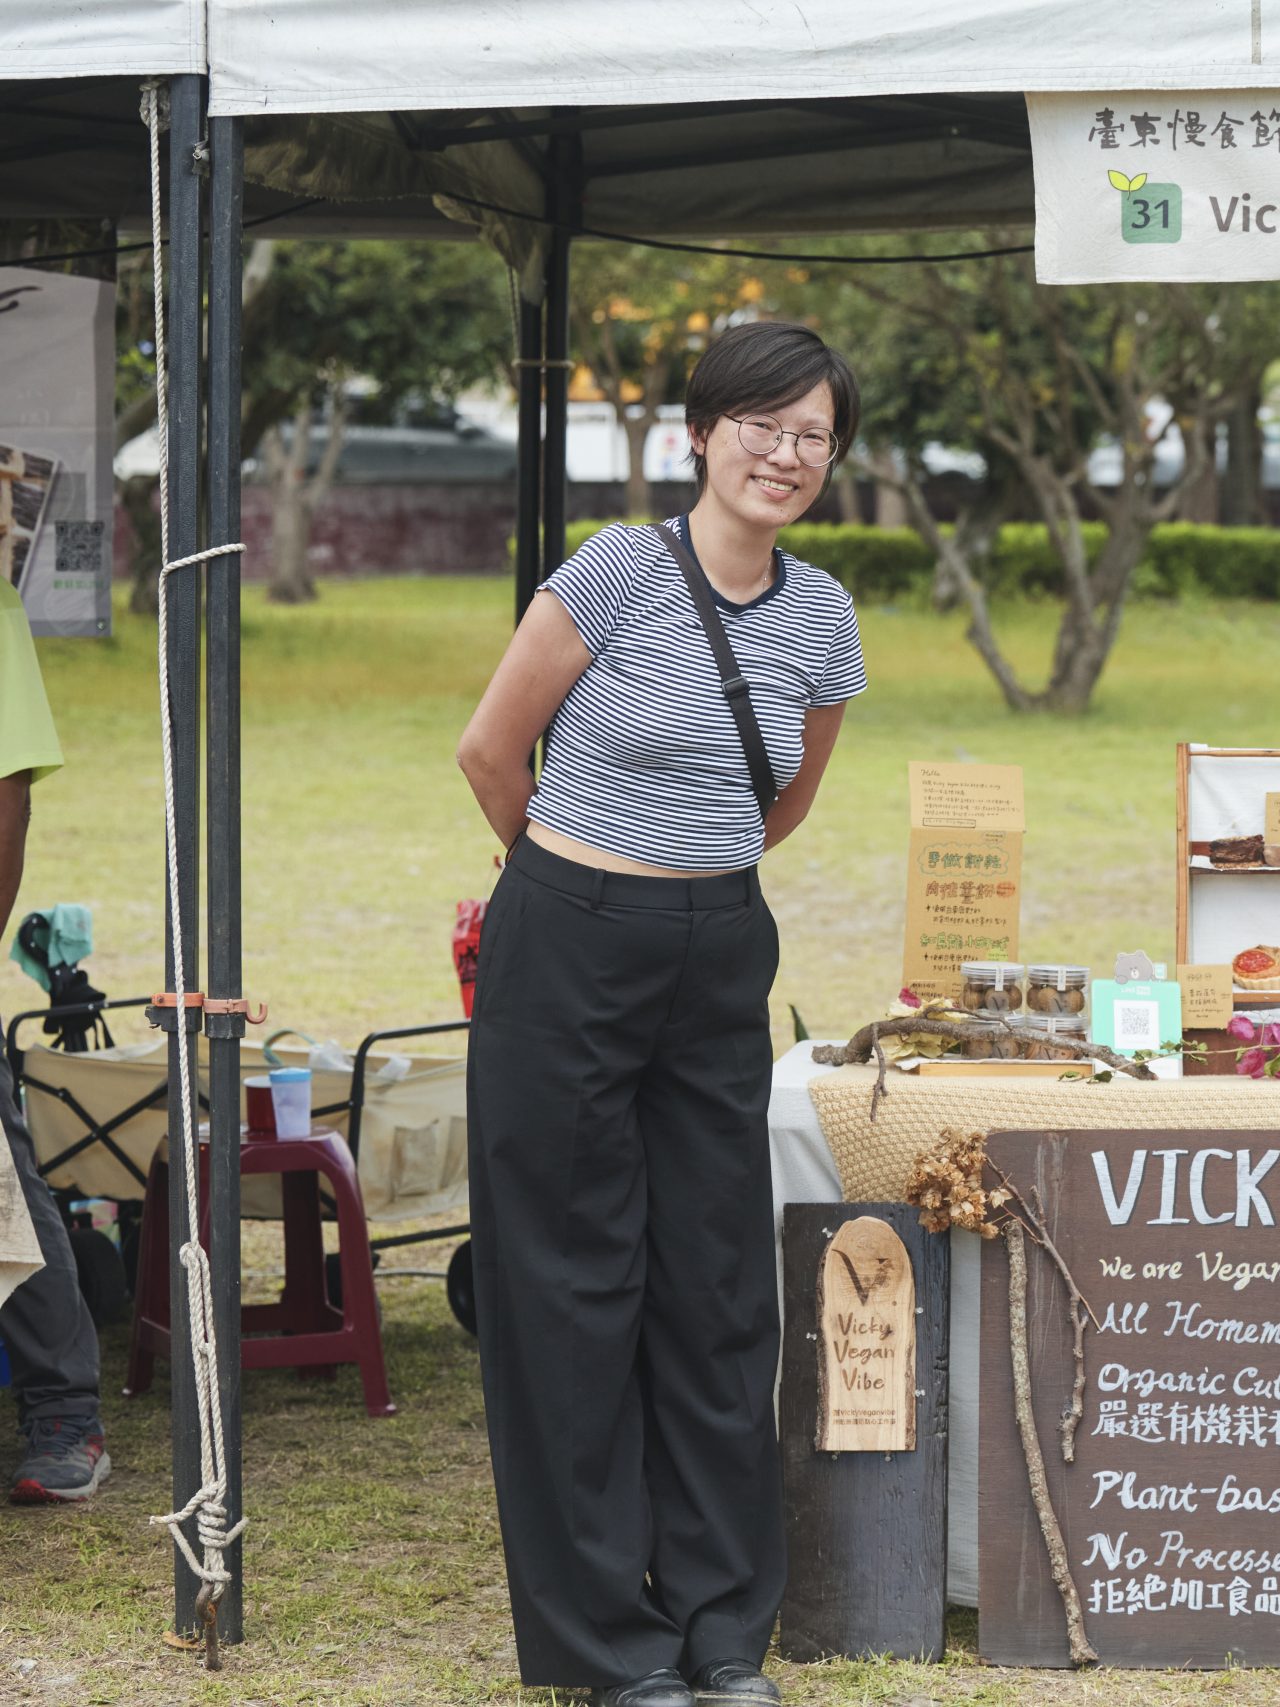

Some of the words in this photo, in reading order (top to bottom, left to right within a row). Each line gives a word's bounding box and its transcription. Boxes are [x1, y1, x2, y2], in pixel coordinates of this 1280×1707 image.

[1131, 198, 1169, 229] 31
[1142, 1260, 1183, 1280] are
[838, 1312, 893, 1341] Vicky
[1100, 1302, 1149, 1335] All
[834, 1340, 896, 1365] Vegan
[842, 1367, 886, 1391] Vibe
[1097, 1363, 1227, 1398] Organic
[1082, 1532, 1148, 1571] No
